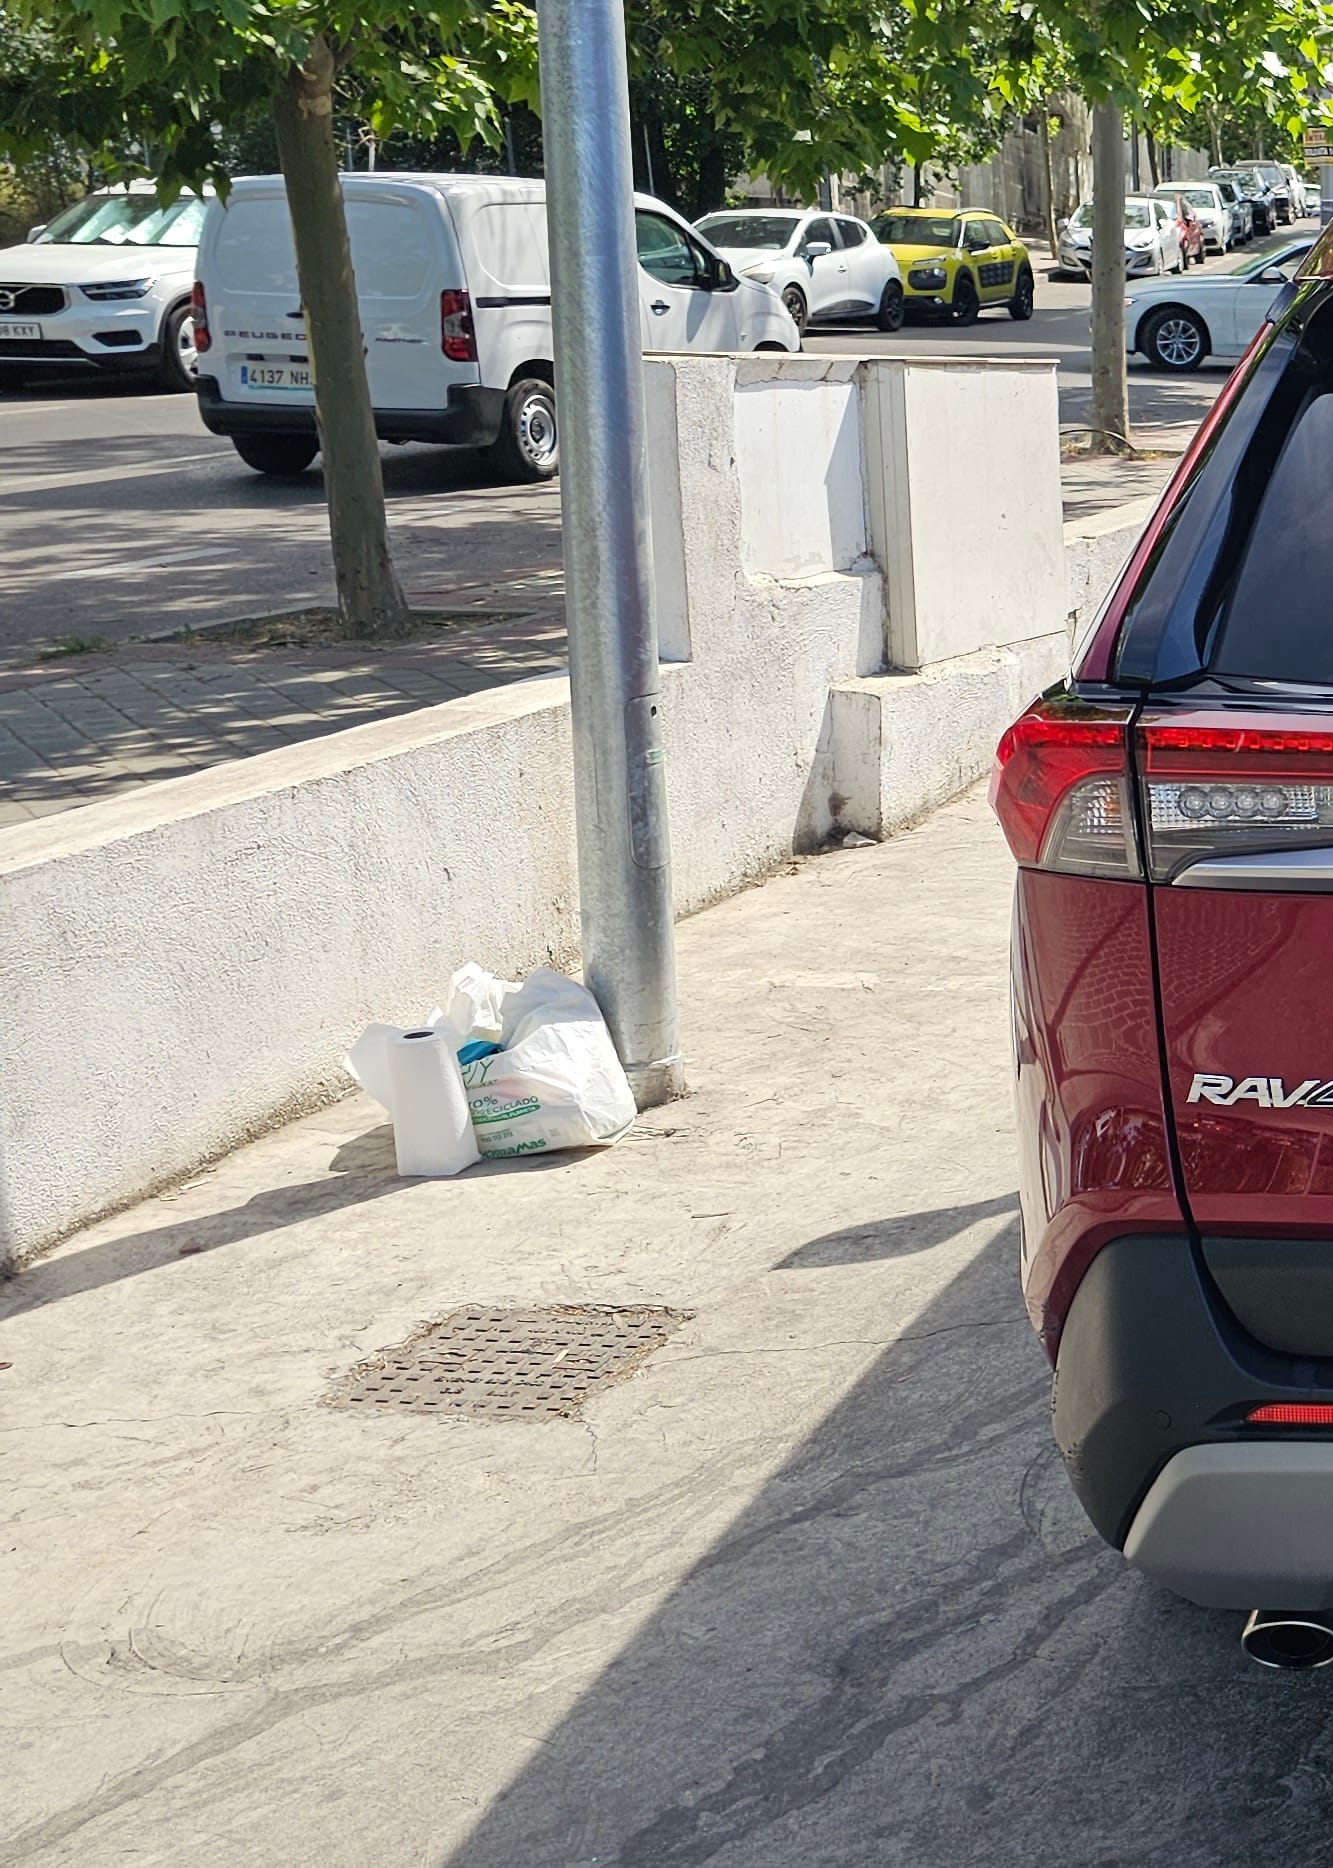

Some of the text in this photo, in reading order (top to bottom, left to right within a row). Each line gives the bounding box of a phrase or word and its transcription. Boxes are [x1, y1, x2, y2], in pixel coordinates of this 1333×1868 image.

[224, 330, 307, 341] PEUGEO
[250, 369, 312, 386] 4137 NH
